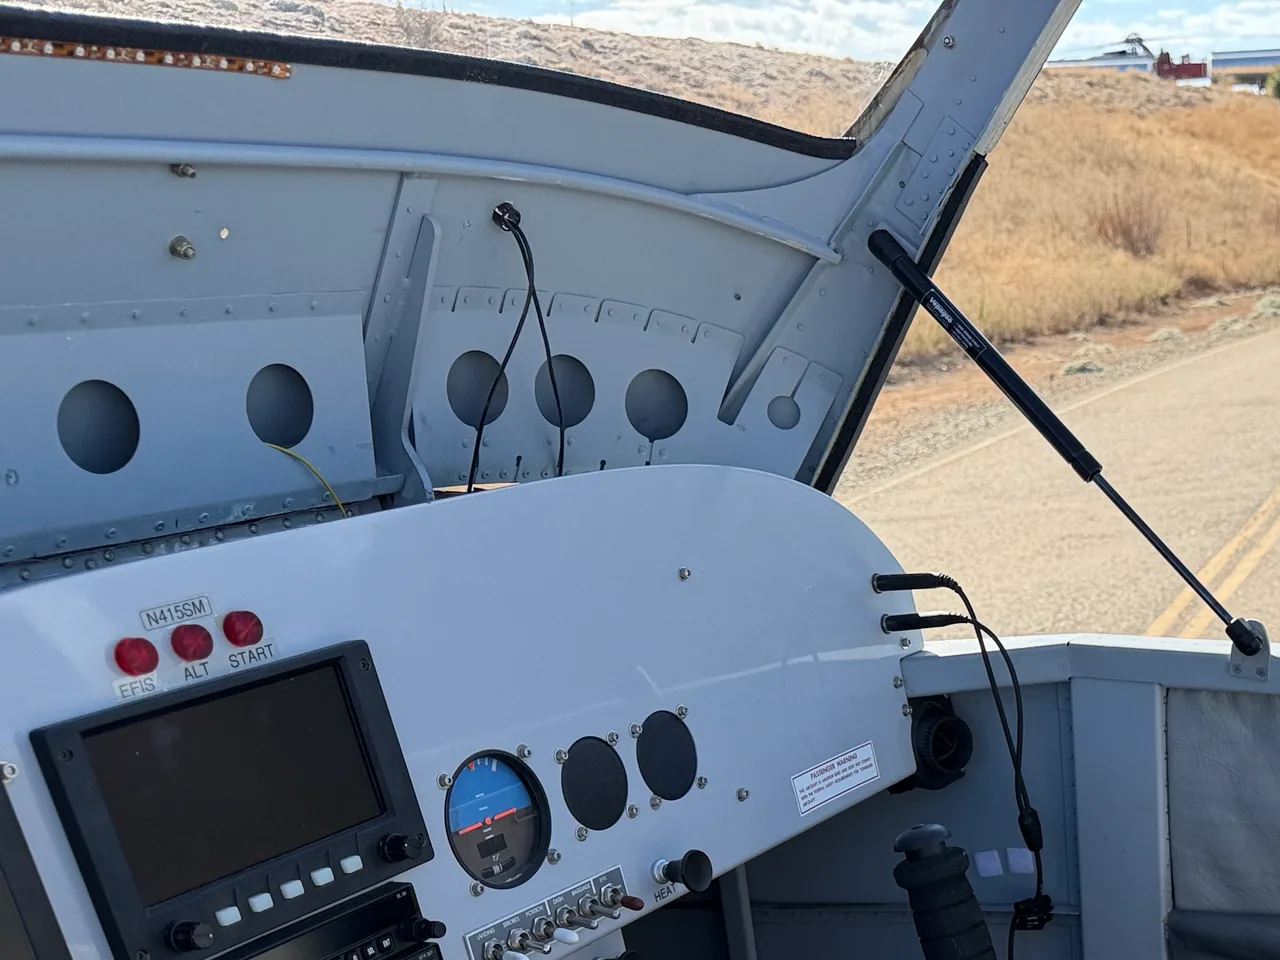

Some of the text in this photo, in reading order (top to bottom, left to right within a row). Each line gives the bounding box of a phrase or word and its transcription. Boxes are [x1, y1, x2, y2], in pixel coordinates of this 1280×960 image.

[929, 297, 952, 323] Vepagoo
[146, 600, 206, 627] N415SM
[228, 644, 275, 668] START
[184, 662, 209, 681] ALT
[118, 678, 156, 698] EFIS
[811, 763, 835, 780] PASSENGER
[837, 753, 858, 767] WARNING
[654, 883, 678, 903] HEAT
[476, 927, 496, 941] LANDING
